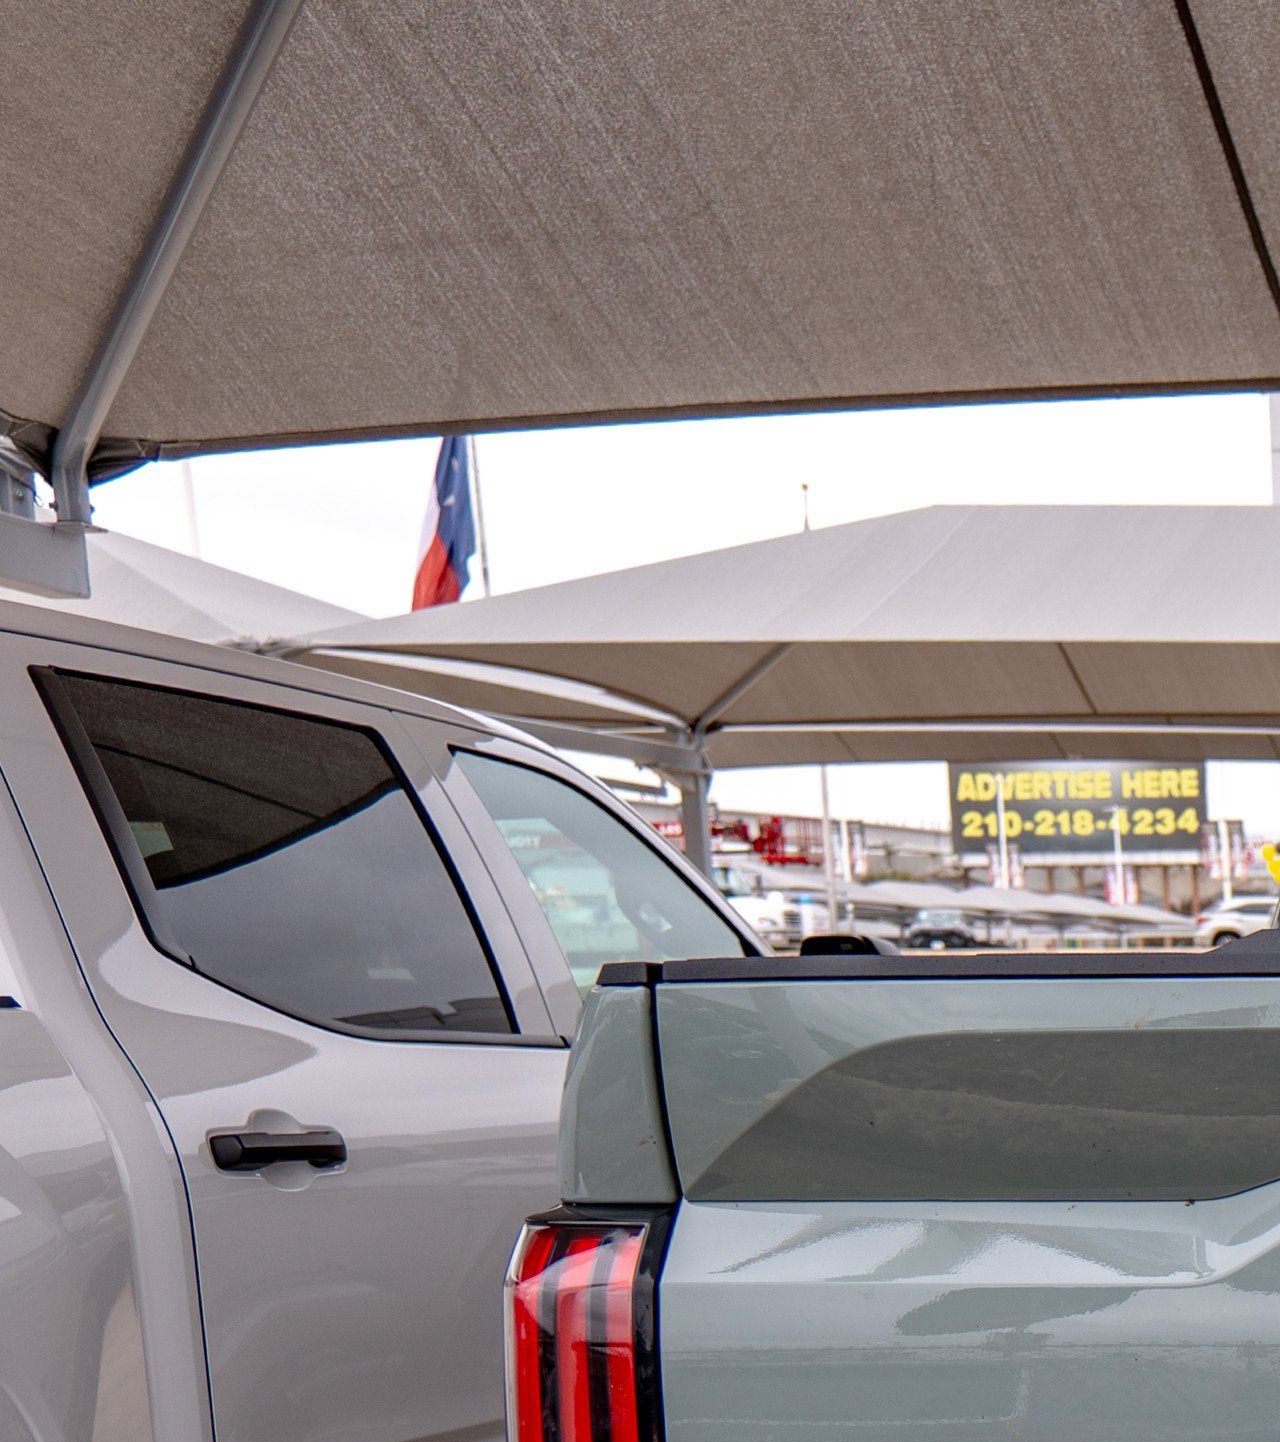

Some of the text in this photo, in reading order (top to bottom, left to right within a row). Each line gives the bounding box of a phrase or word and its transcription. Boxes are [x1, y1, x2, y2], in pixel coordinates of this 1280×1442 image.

[957, 768, 1199, 801] ADVERTISE HERE
[961, 807, 1199, 837] 210-218-4234
